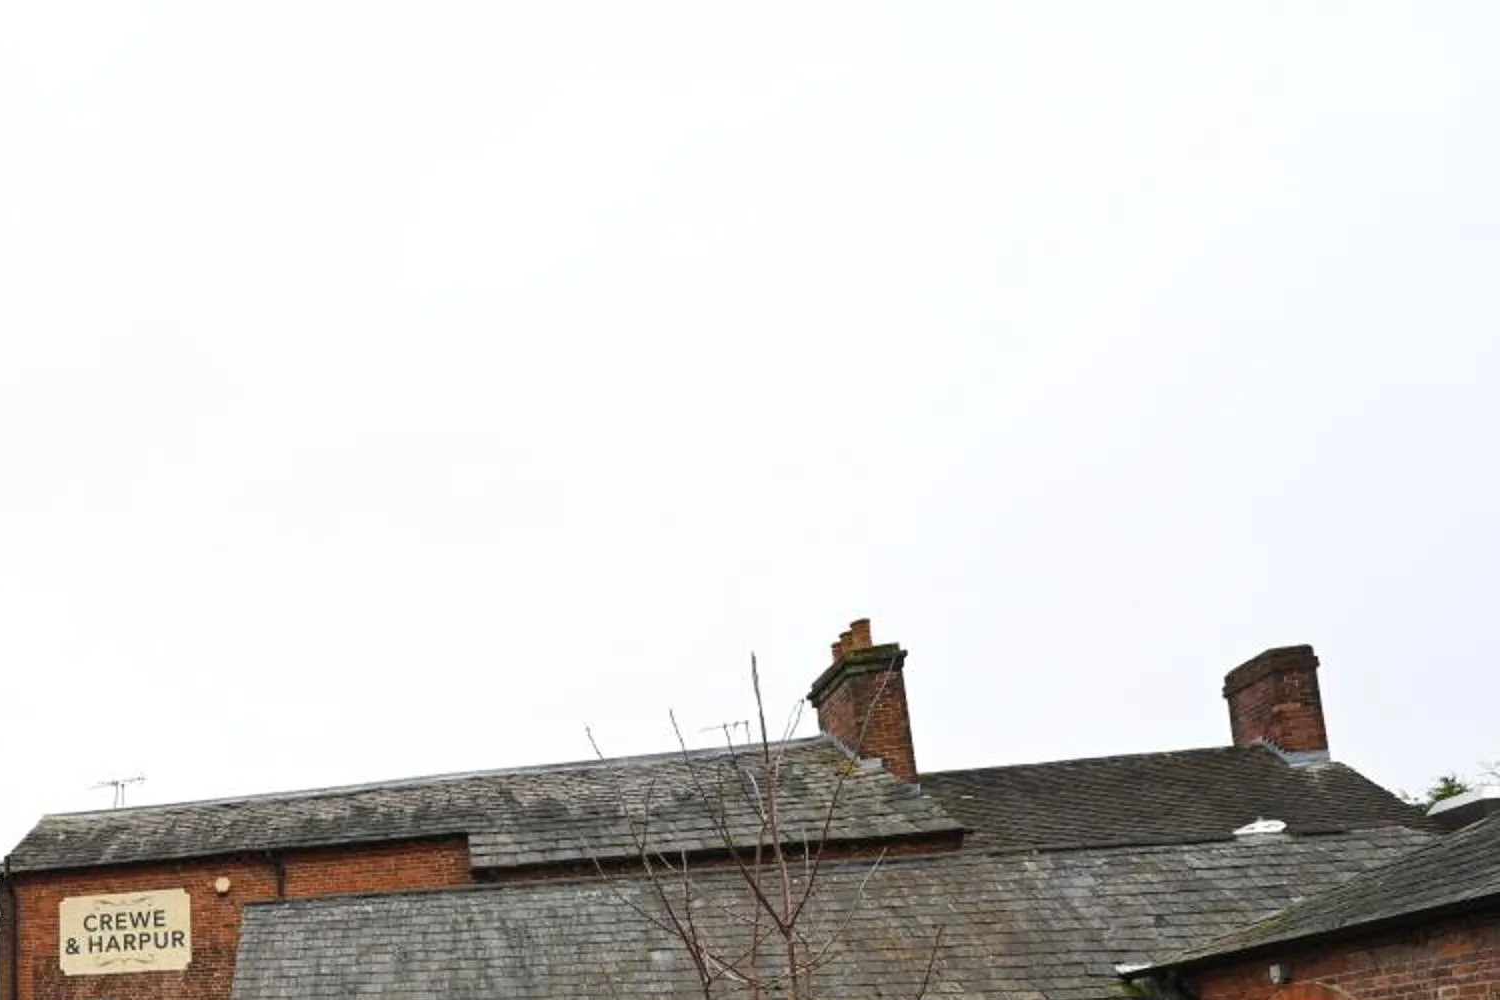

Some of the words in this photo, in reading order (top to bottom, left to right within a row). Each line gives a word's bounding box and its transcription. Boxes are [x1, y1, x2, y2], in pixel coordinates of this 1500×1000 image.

[83, 909, 166, 932] CREWE
[65, 937, 80, 955] &
[88, 930, 185, 954] HARPUR
